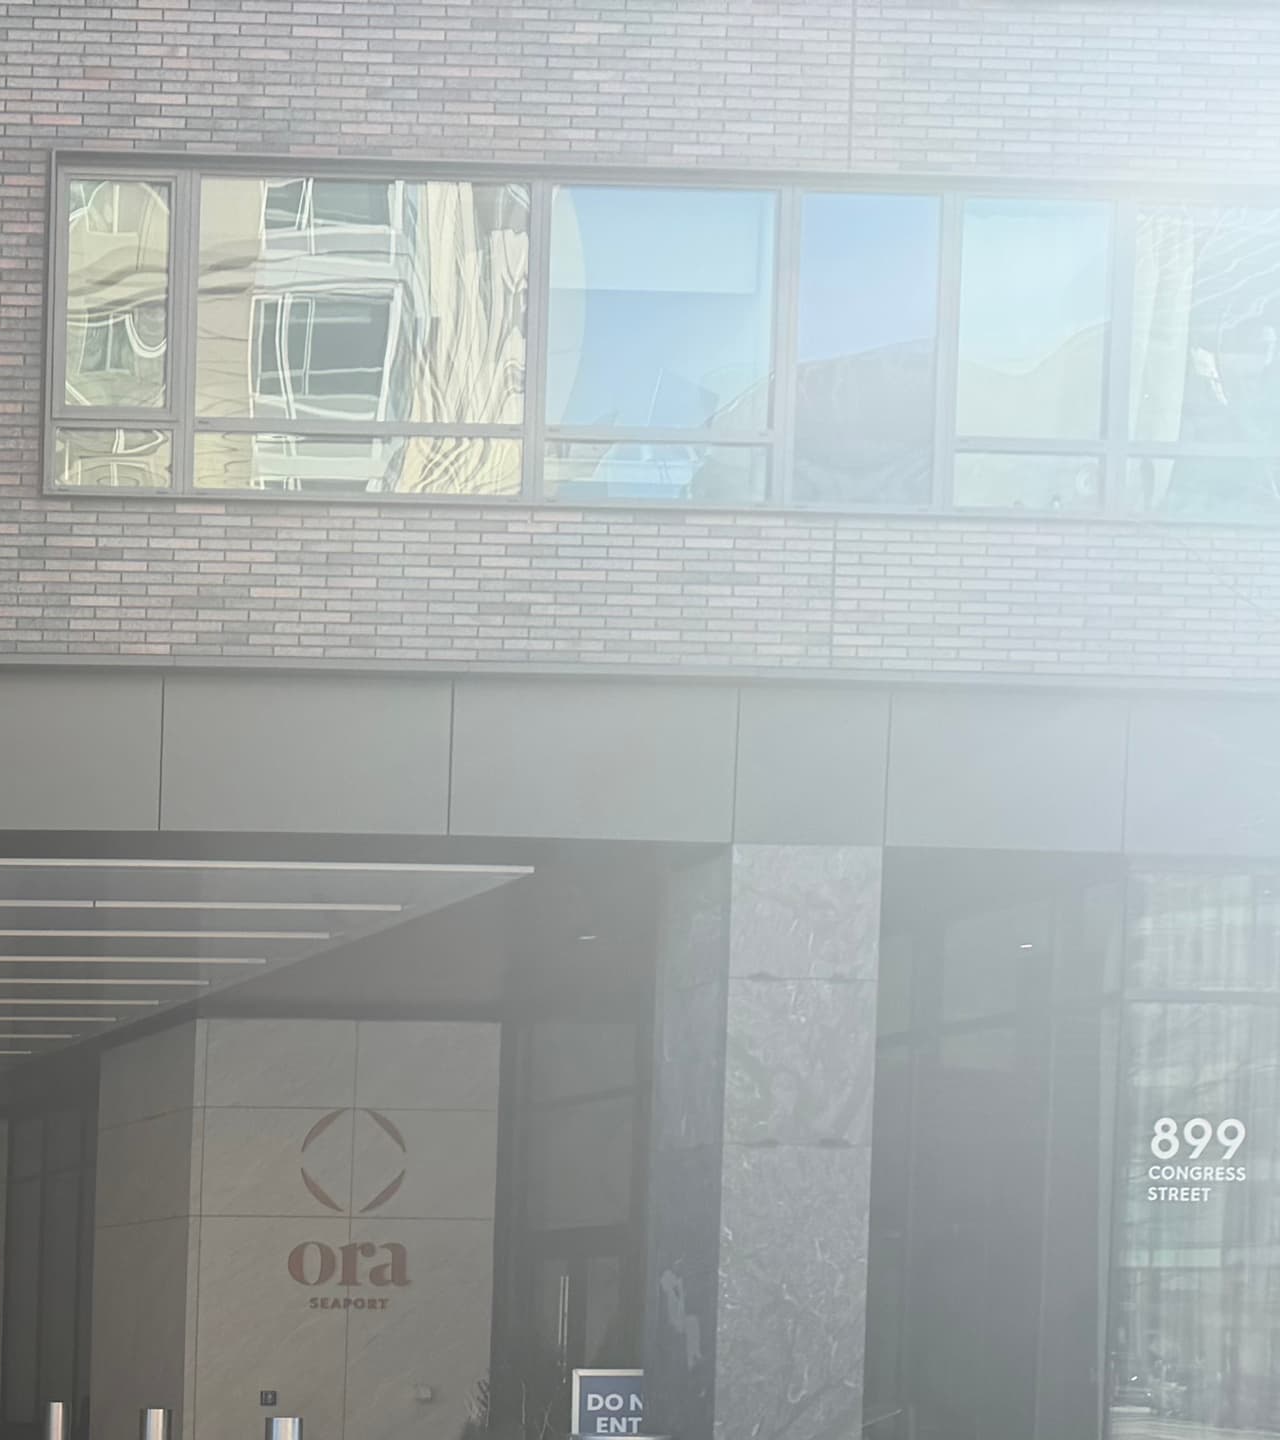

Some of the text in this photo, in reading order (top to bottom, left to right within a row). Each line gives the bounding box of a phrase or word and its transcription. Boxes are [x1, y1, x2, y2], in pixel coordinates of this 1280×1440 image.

[1150, 1117, 1246, 1160] 899
[1148, 1165, 1247, 1181] CONGRESS
[1147, 1187, 1212, 1201] STREET
[287, 1240, 412, 1287] ora
[309, 1297, 390, 1310] SEAPORT
[586, 1393, 624, 1411] DO
